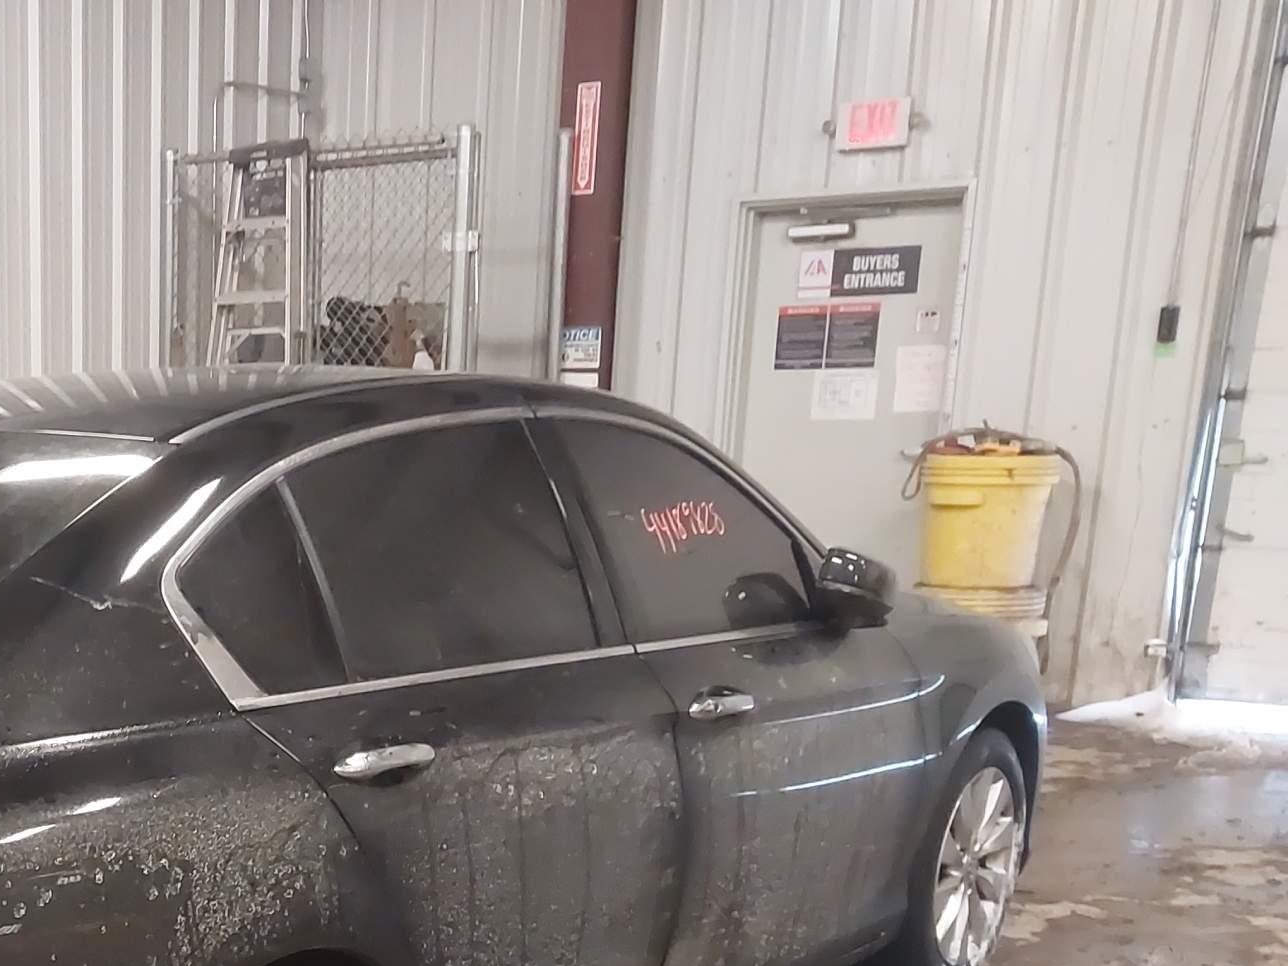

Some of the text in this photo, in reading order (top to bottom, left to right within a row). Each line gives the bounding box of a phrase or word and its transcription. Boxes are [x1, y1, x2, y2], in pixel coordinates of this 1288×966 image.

[848, 101, 899, 143] EXIT
[852, 254, 899, 271] BUYERS
[843, 271, 905, 289] ENTRANCE
